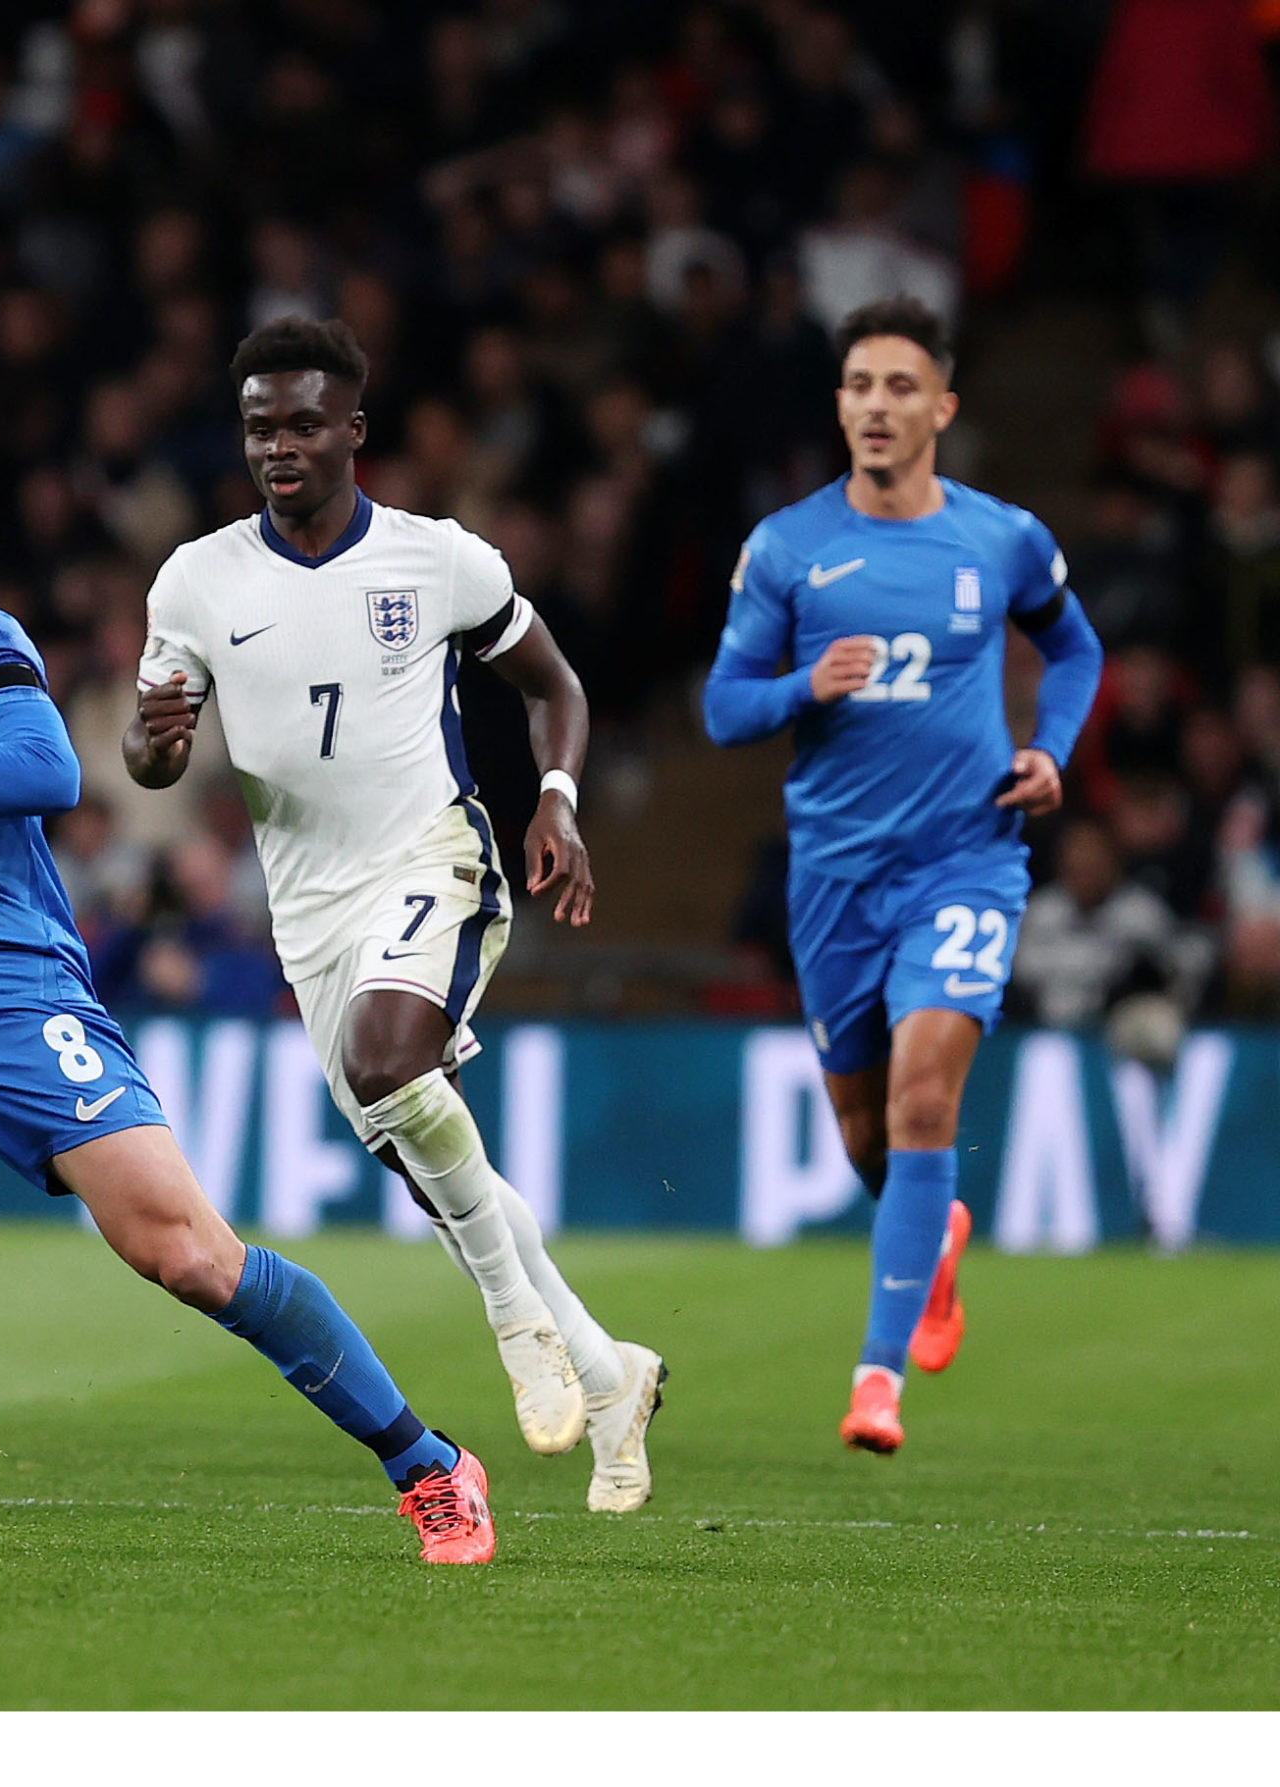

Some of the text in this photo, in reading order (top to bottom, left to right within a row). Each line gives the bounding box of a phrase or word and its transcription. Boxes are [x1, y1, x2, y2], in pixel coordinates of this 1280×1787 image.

[851, 631, 933, 702] 22
[309, 682, 343, 760] 7
[400, 894, 439, 942] 7
[931, 904, 1008, 980] 22
[43, 1013, 104, 1083] 8
